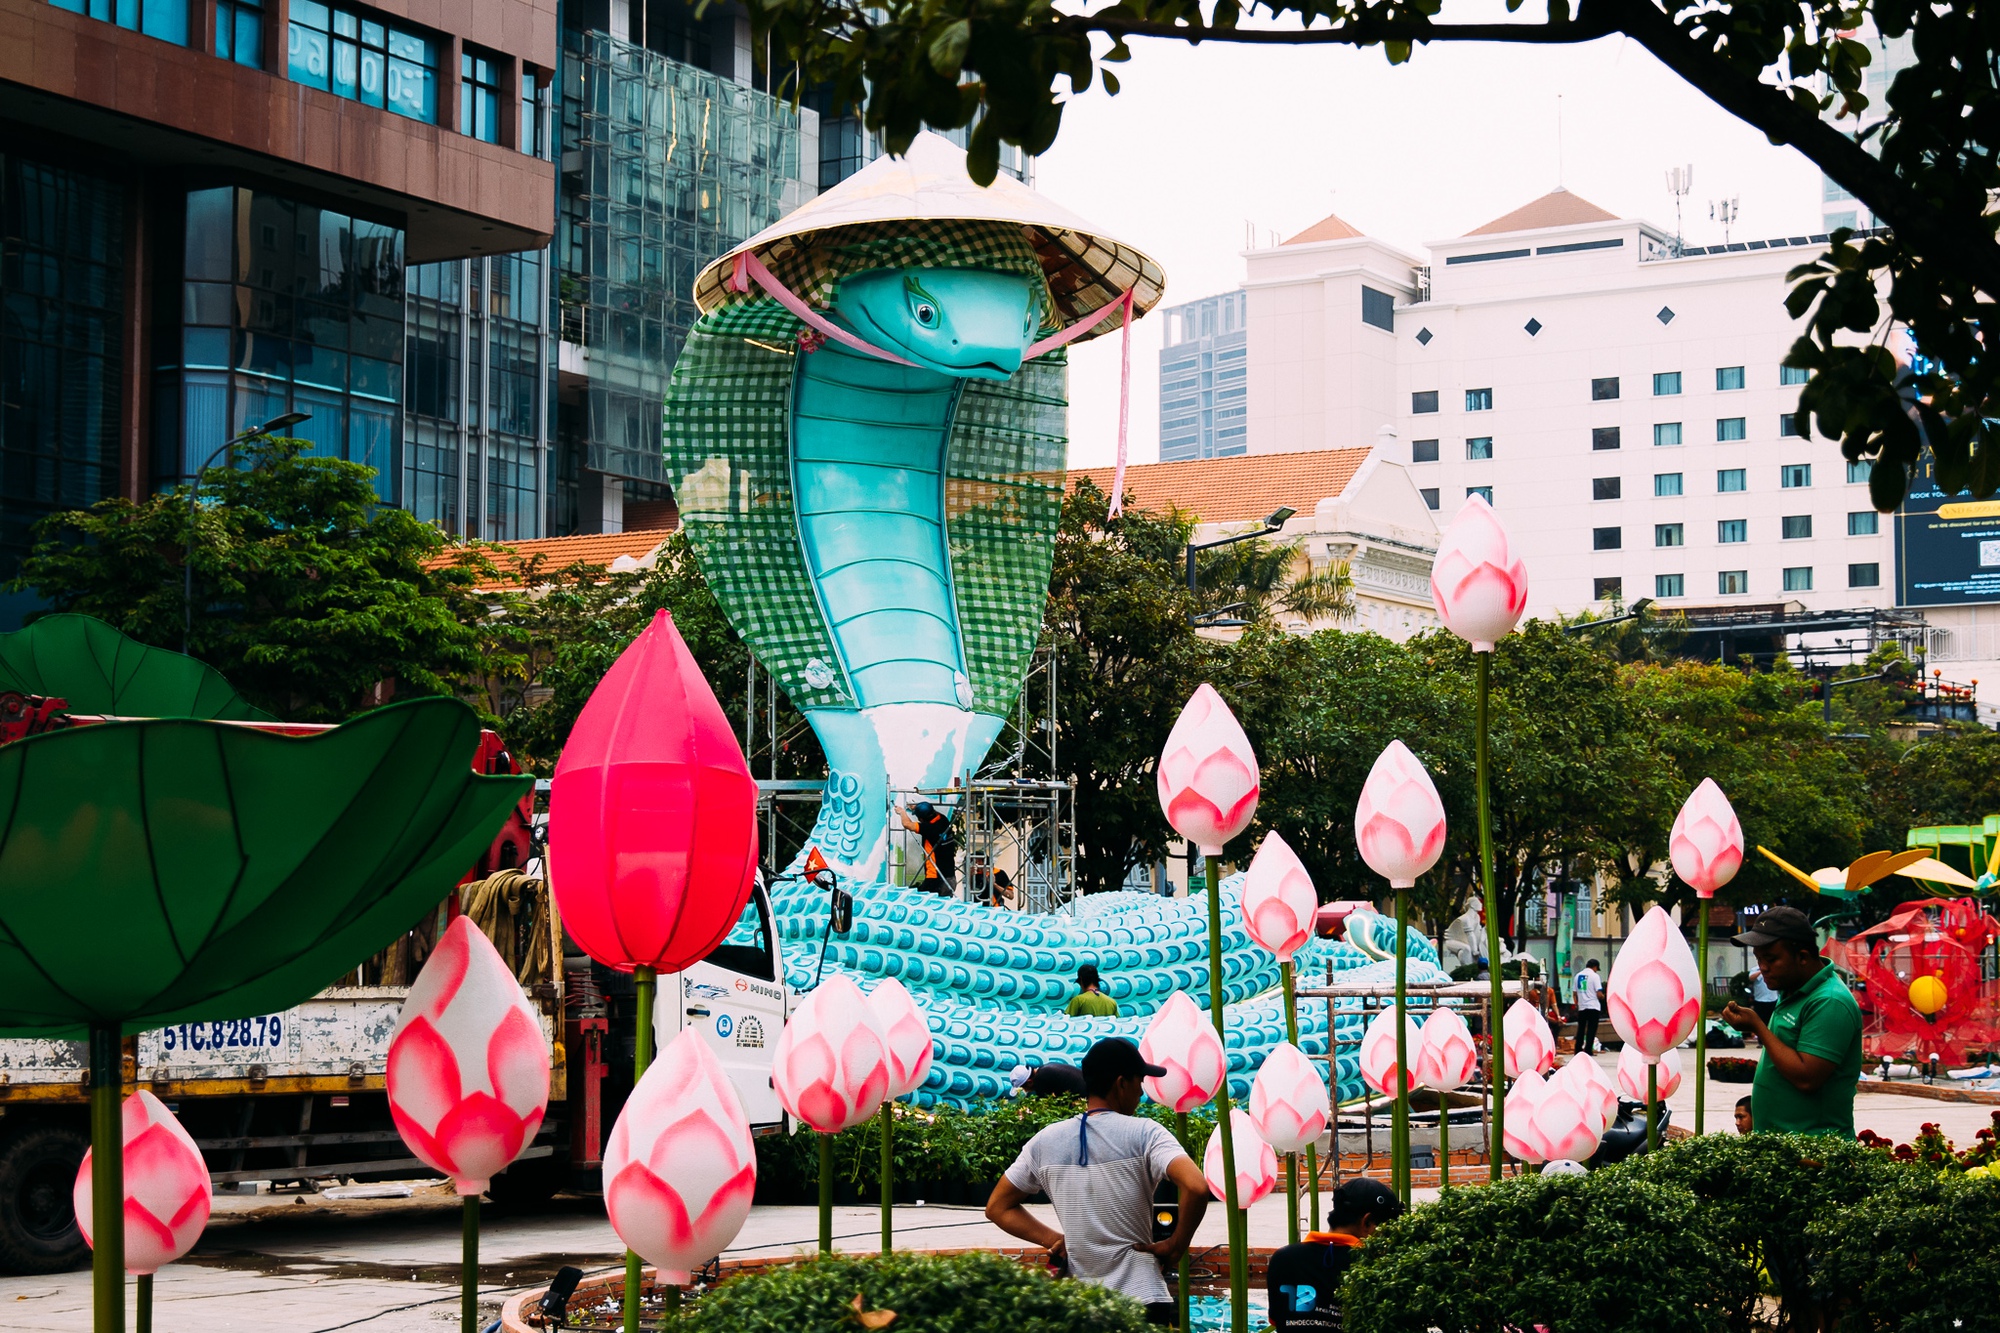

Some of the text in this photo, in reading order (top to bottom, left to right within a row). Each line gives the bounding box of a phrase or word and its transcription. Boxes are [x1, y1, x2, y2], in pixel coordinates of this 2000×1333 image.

[1910, 491, 1930, 499] BOOK
[750, 983, 782, 1000] HINO
[163, 1015, 282, 1051] 51C.828.79
